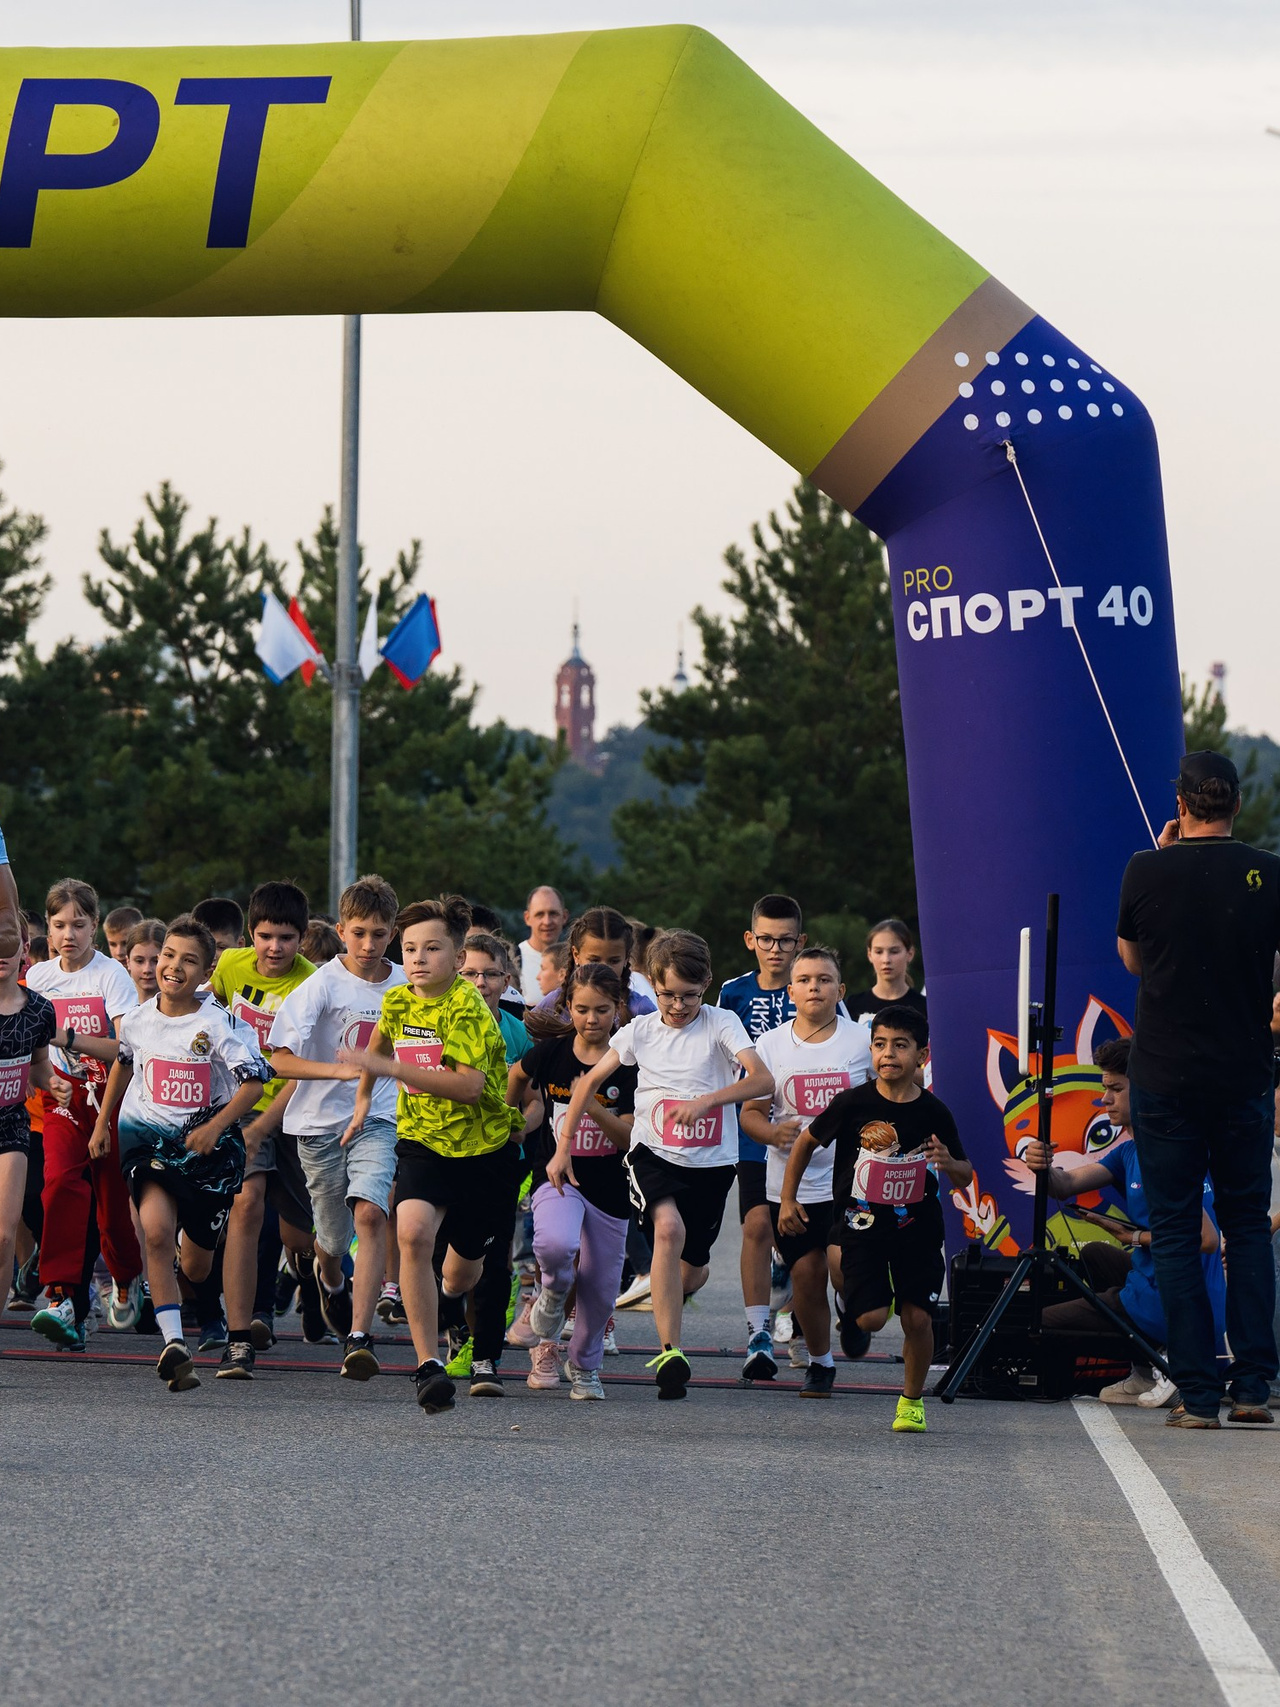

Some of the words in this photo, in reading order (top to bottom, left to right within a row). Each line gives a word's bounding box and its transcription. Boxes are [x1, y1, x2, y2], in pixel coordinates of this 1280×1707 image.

[903, 565, 953, 596] PRO
[906, 585, 1084, 642] СПОРТ
[1097, 585, 1154, 627] 40
[67, 1003, 90, 1014] СОФЬЯ
[62, 1014, 102, 1036] 4299
[403, 1026, 420, 1036] FREE
[415, 1053, 432, 1064] ГЛЕБ
[168, 1068, 195, 1081] ДАВИД
[804, 1076, 842, 1088] ИЛЛАРИОН
[160, 1079, 204, 1103] 3203
[575, 1129, 614, 1150] 1674
[884, 1167, 917, 1179] АРСЕНИЙ
[882, 1179, 916, 1200] 907
[210, 1208, 227, 1231] 5
